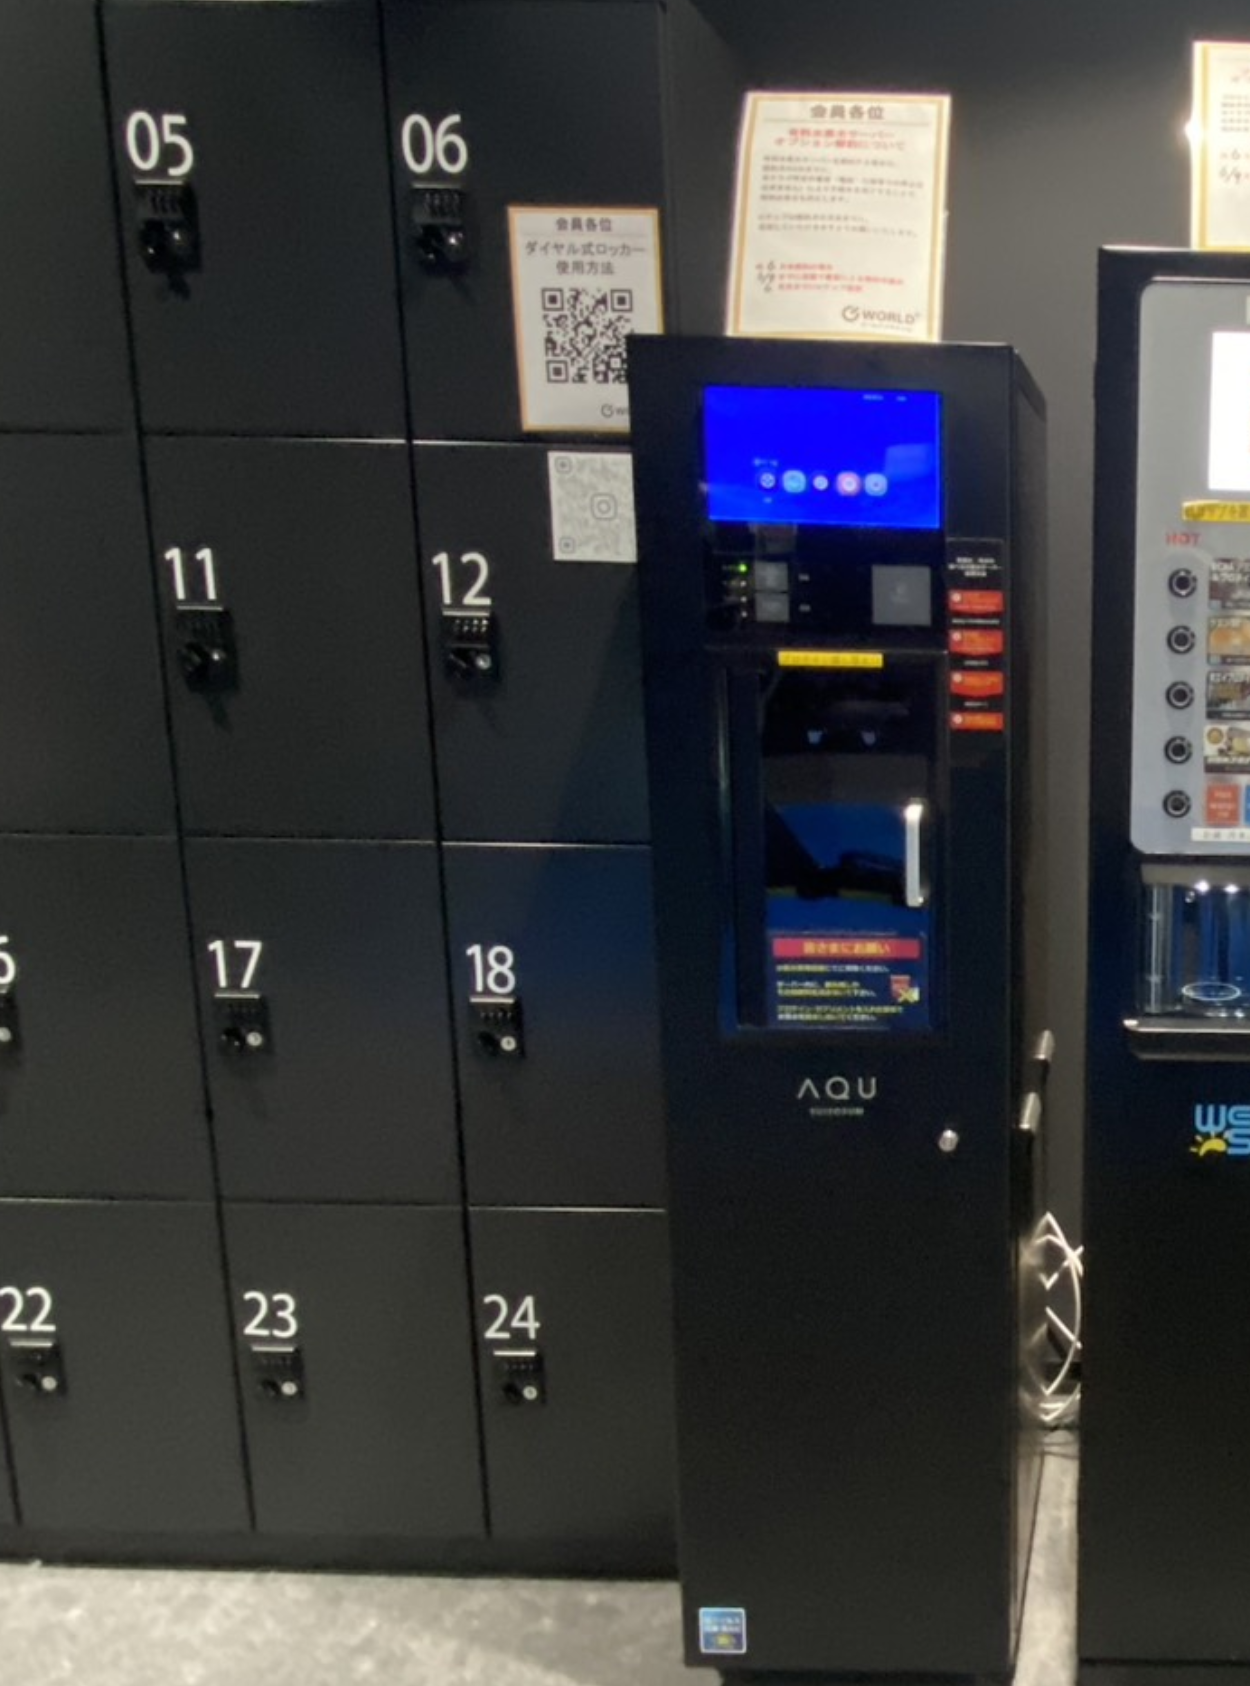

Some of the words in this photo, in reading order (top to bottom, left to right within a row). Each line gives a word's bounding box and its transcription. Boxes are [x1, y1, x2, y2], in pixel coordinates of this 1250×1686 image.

[810, 105, 885, 120] 会員各位
[126, 111, 194, 176] 05
[402, 114, 468, 174] 06
[556, 217, 612, 232] 会員各位
[526, 241, 646, 256] ダイヤル式ロッカー
[556, 260, 615, 275] 使用方法
[165, 548, 218, 601] 11
[432, 552, 492, 605] 12
[208, 940, 263, 989] 17
[466, 944, 516, 993] 18
[0, 1286, 56, 1332] 22
[243, 1291, 298, 1338] 23
[483, 1295, 541, 1341] 24
